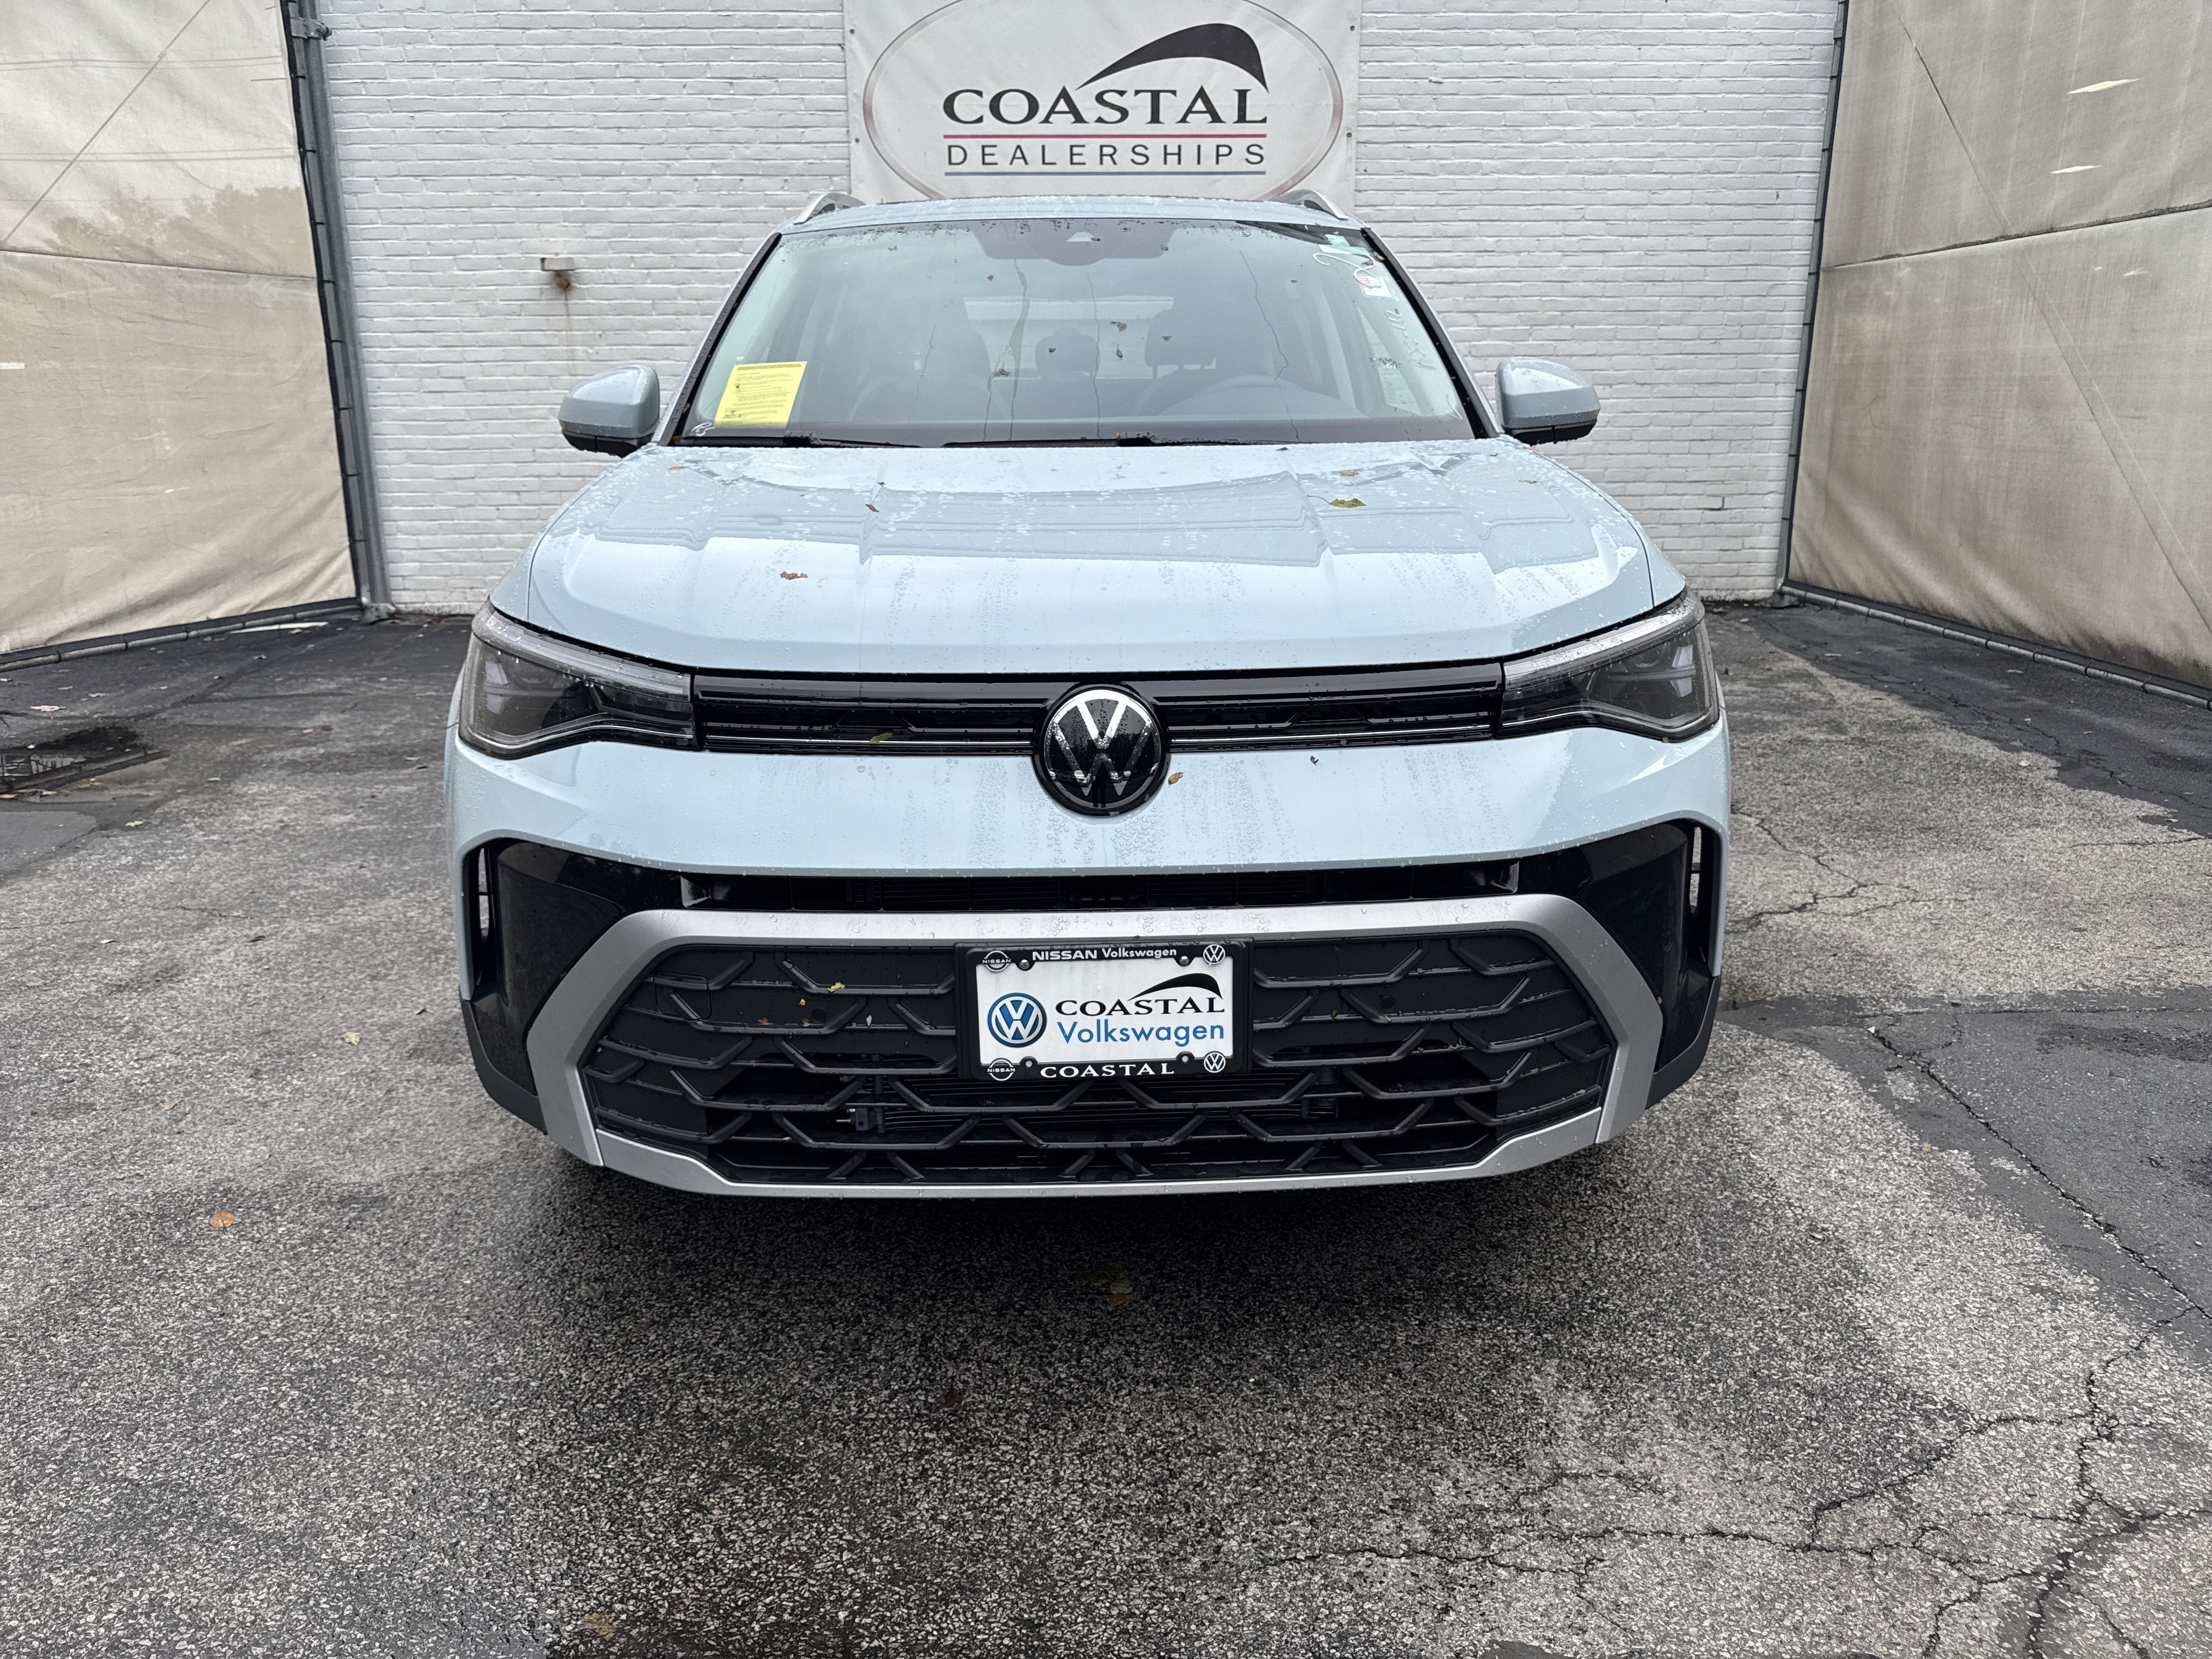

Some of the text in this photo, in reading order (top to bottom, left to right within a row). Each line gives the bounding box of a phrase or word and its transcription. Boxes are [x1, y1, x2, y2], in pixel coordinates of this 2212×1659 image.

[943, 84, 1267, 125] COASTAL
[947, 144, 1265, 166] DEALERSHIPS
[1032, 947, 1177, 961] NISSAN Volkswagen
[1055, 996, 1225, 1017] COASTAL
[1057, 1019, 1224, 1047] Volkswagen
[1040, 1063, 1175, 1079] COASTAL
